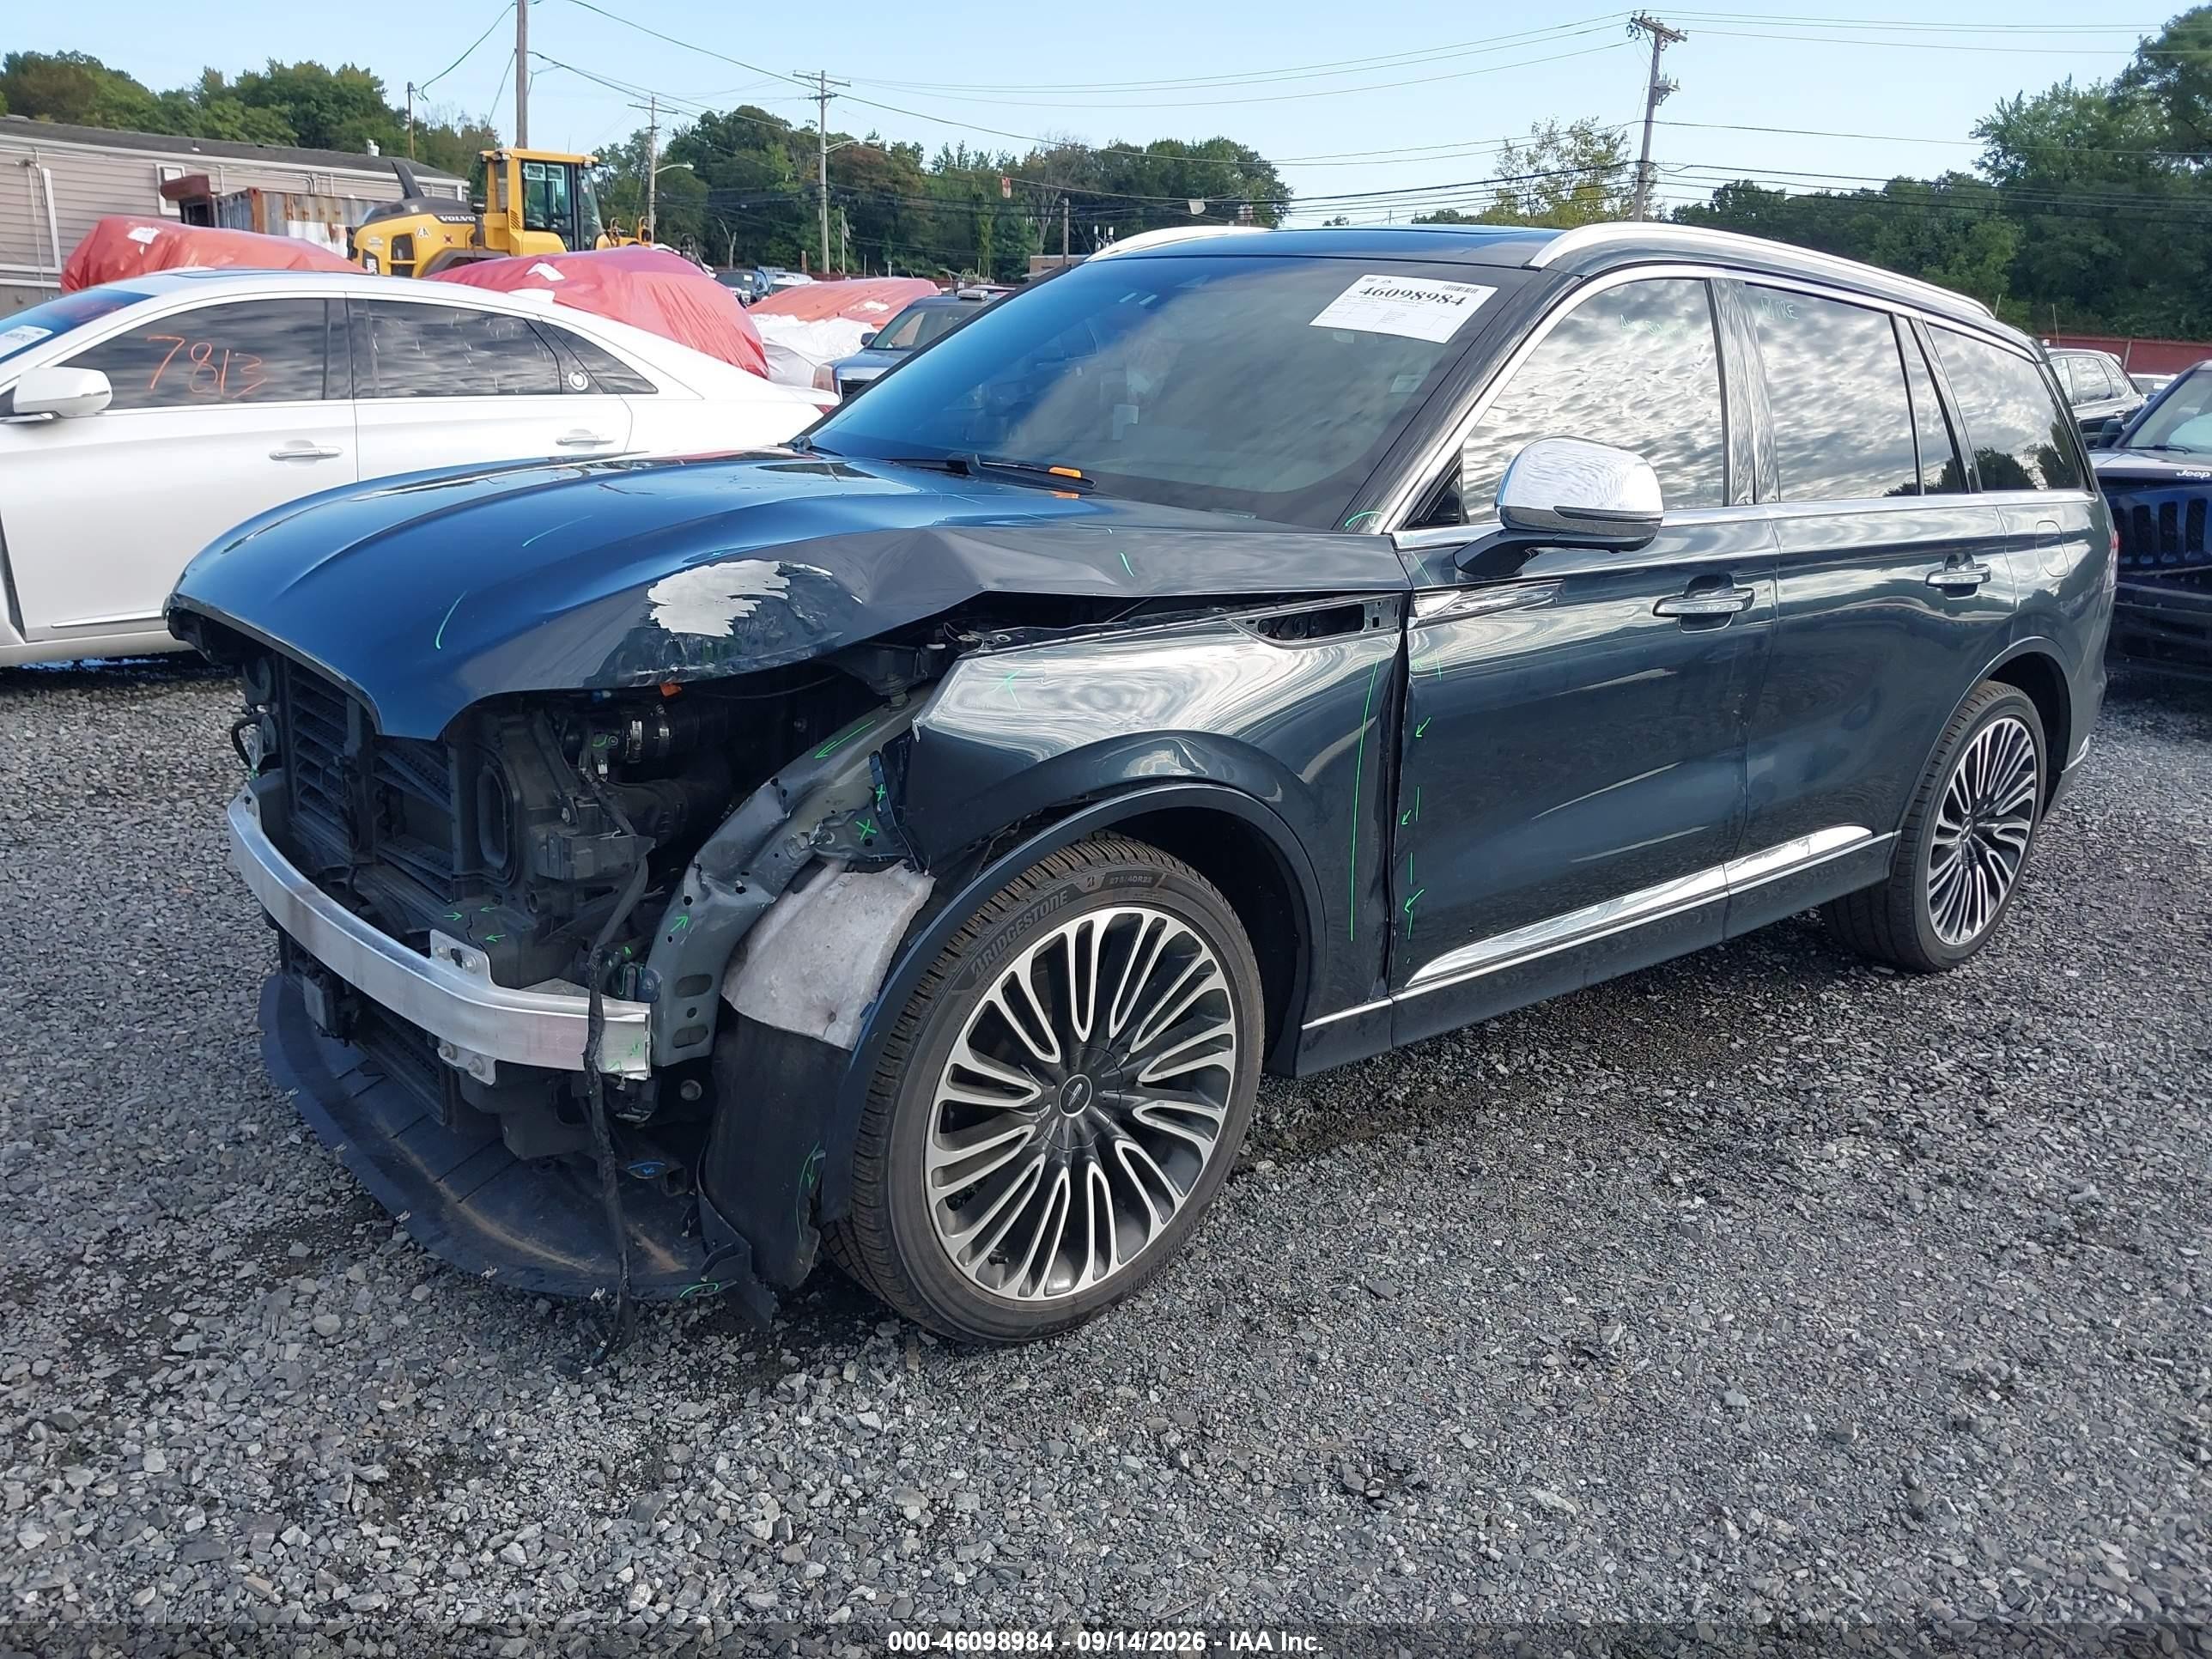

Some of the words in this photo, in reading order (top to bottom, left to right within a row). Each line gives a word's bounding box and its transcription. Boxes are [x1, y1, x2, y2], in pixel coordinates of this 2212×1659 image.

[1358, 286, 1467, 307] 46098984
[146, 335, 268, 399] 7813
[2176, 470, 2211, 479] Jeep
[969, 890, 1068, 978] BRIDGESTONE
